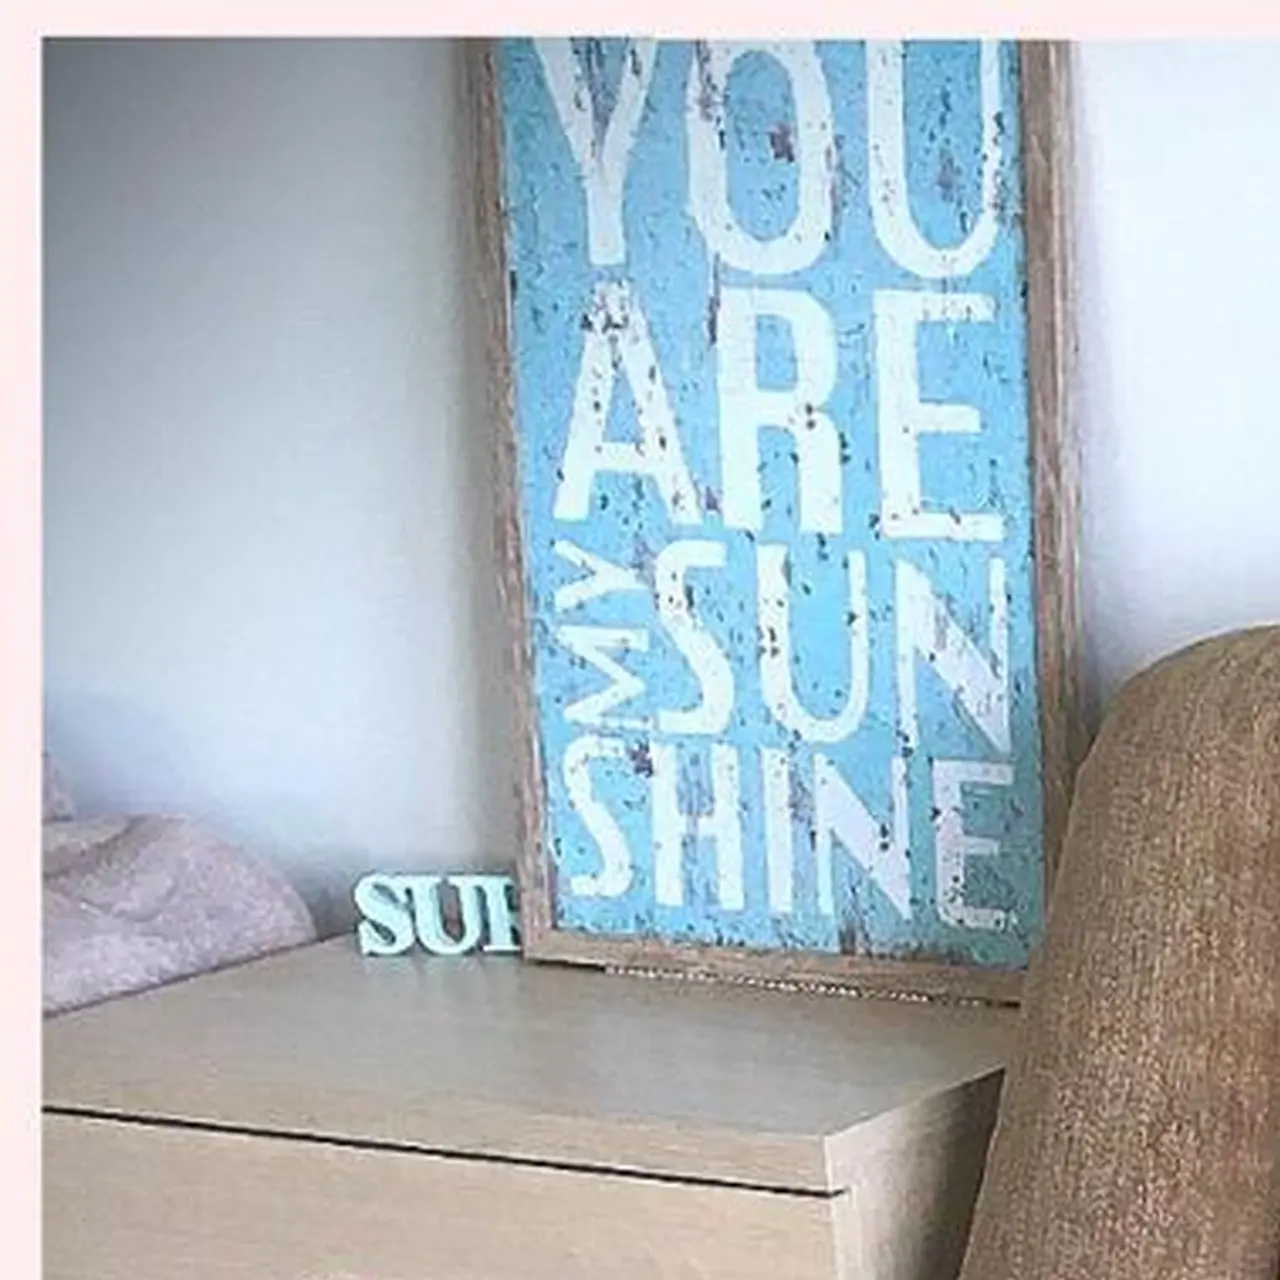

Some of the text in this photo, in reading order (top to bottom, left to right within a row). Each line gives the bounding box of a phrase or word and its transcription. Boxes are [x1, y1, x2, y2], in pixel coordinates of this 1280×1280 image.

[531, 38, 1002, 278] YOU
[553, 279, 1001, 542] ARE
[552, 540, 655, 733] MY
[652, 540, 1012, 757] SUN
[567, 735, 1019, 934] SHINE
